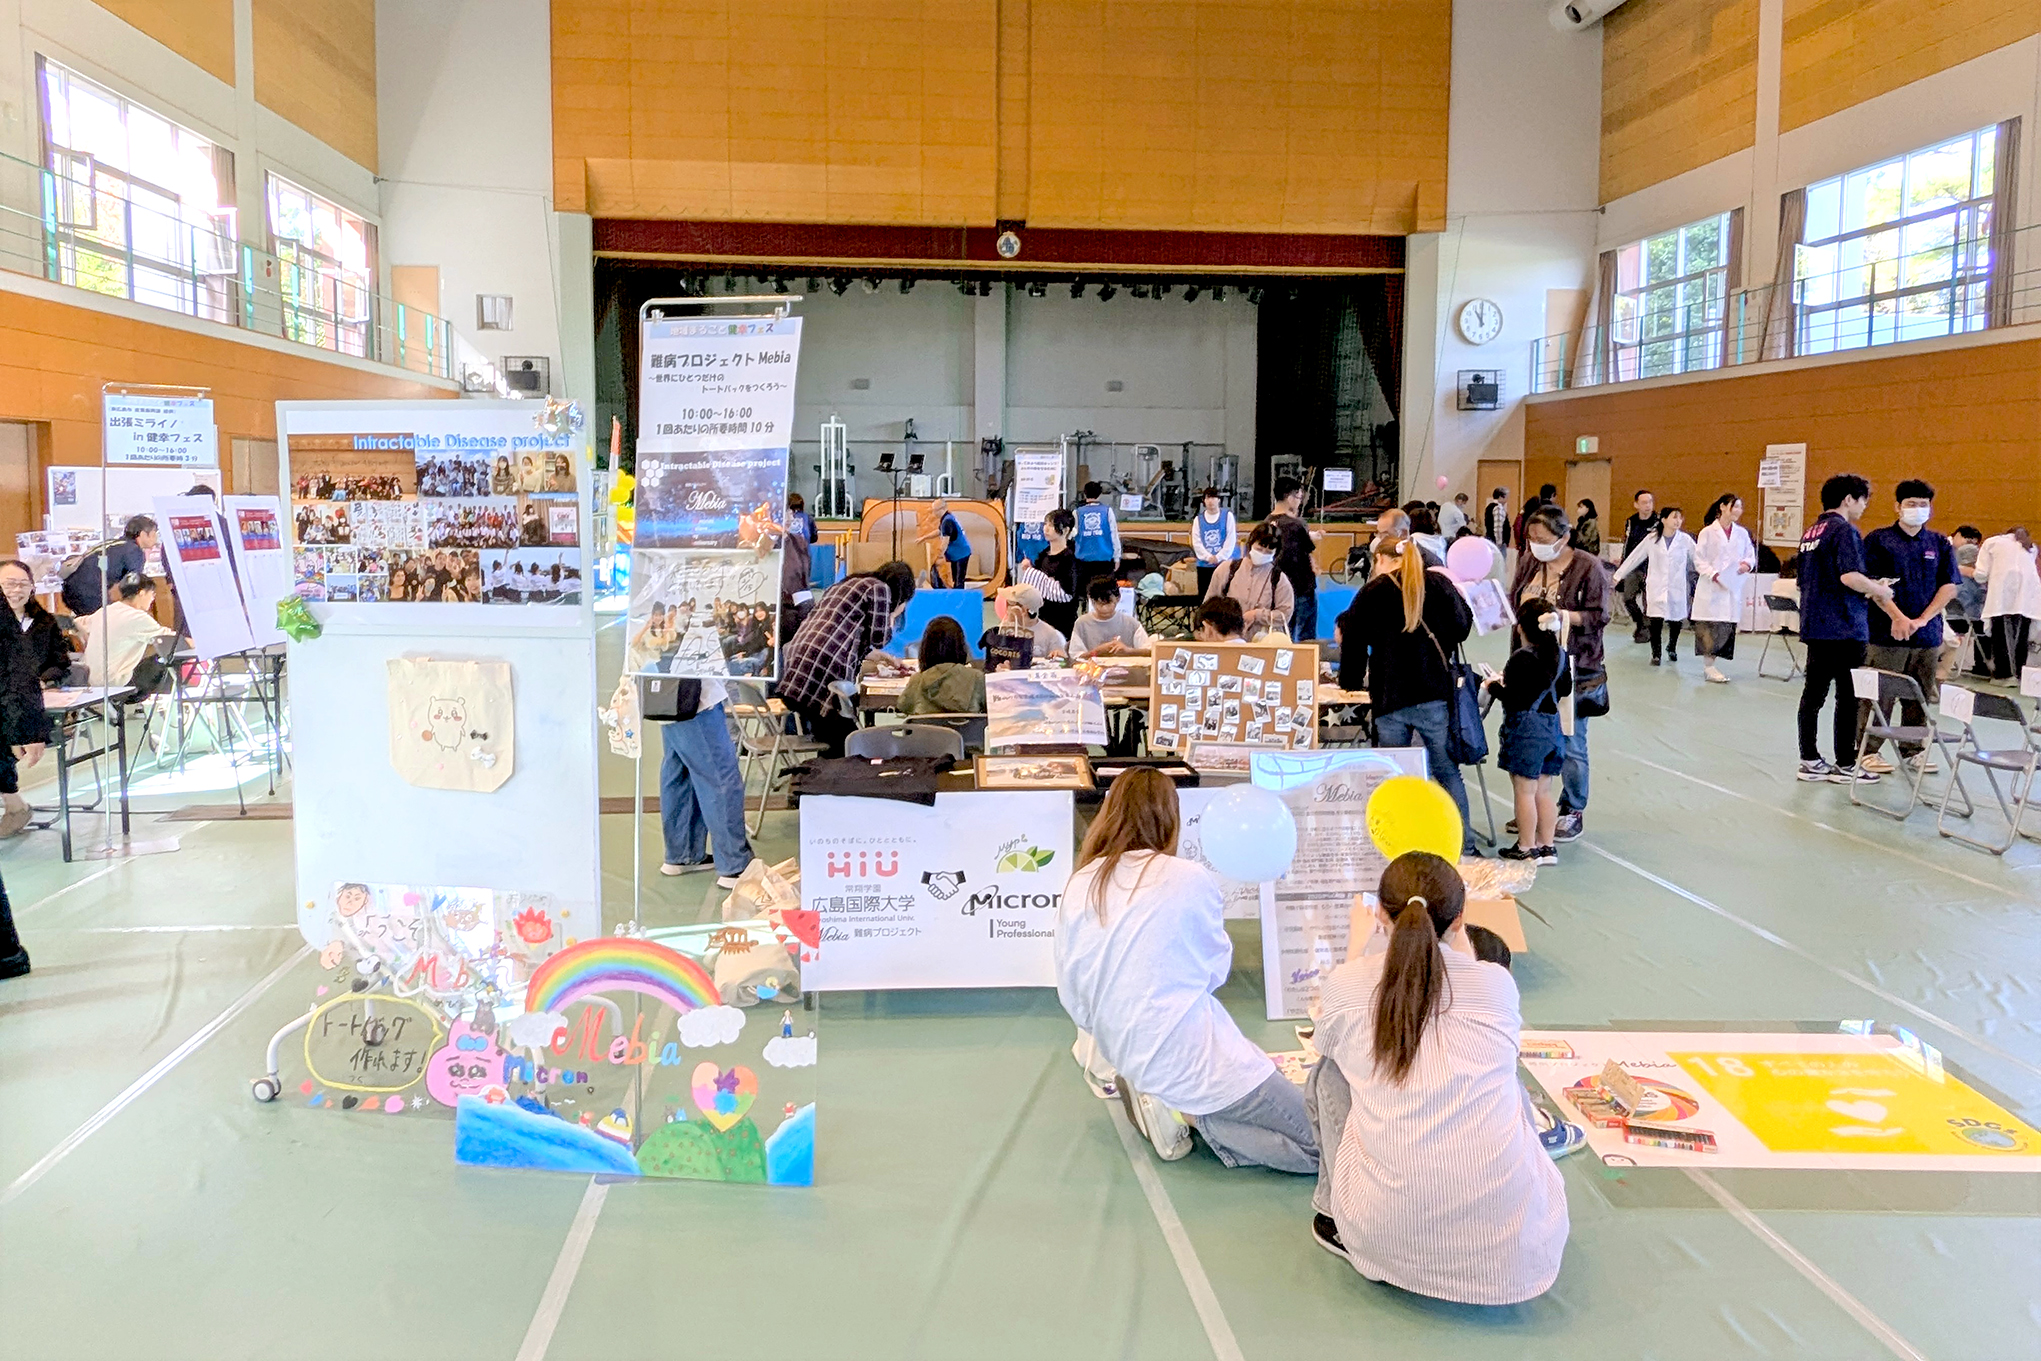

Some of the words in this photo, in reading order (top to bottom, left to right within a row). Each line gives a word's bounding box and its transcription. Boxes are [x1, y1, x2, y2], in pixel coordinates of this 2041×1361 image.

[650, 353, 755, 369] 難病プロジェクト
[758, 350, 791, 364] Mebia
[133, 432, 144, 441] in
[354, 434, 441, 450] Intractable
[444, 434, 507, 449] Disease
[511, 434, 571, 451] project
[660, 461, 710, 471] Intractable
[712, 460, 746, 469] Disease
[747, 459, 781, 469] project
[685, 490, 727, 511] Mebia
[1313, 782, 1364, 803] Mebia
[812, 895, 916, 914] 広島国際大学
[820, 915, 847, 923] oshima
[848, 914, 897, 923] International
[897, 914, 916, 922] Univ.
[996, 919, 1027, 930] Young
[854, 927, 922, 938] 難病プロジェクト
[551, 1004, 682, 1065] Mebia
[503, 1054, 589, 1086] Micron
[1687, 1056, 1754, 1078] 18
